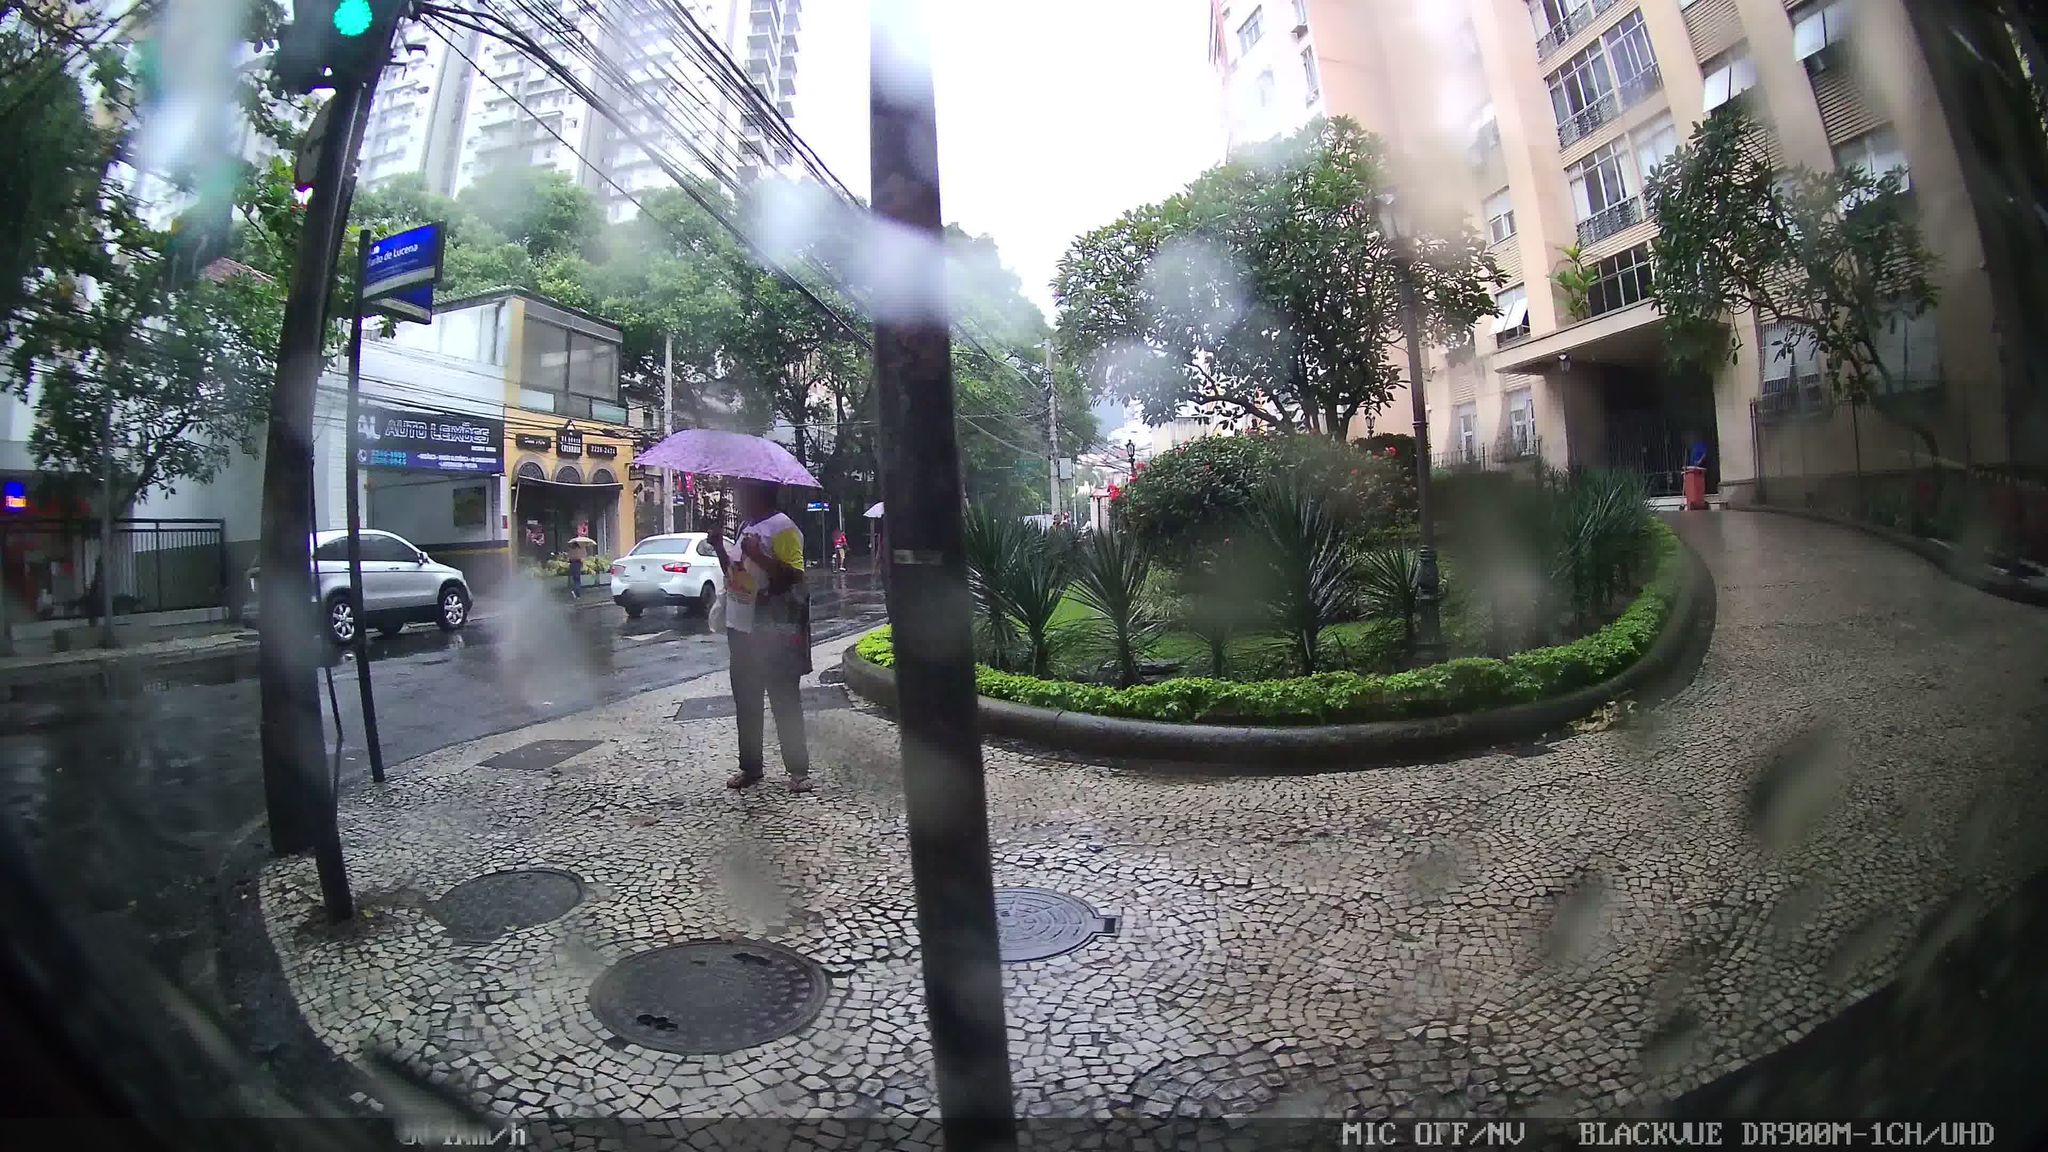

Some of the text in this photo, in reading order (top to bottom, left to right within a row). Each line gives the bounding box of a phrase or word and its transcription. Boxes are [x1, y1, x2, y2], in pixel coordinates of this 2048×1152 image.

[383, 250, 393, 261] de
[393, 244, 419, 258] Lucena
[384, 419, 428, 440] AUTO
[430, 421, 490, 445] LEIXÕES
